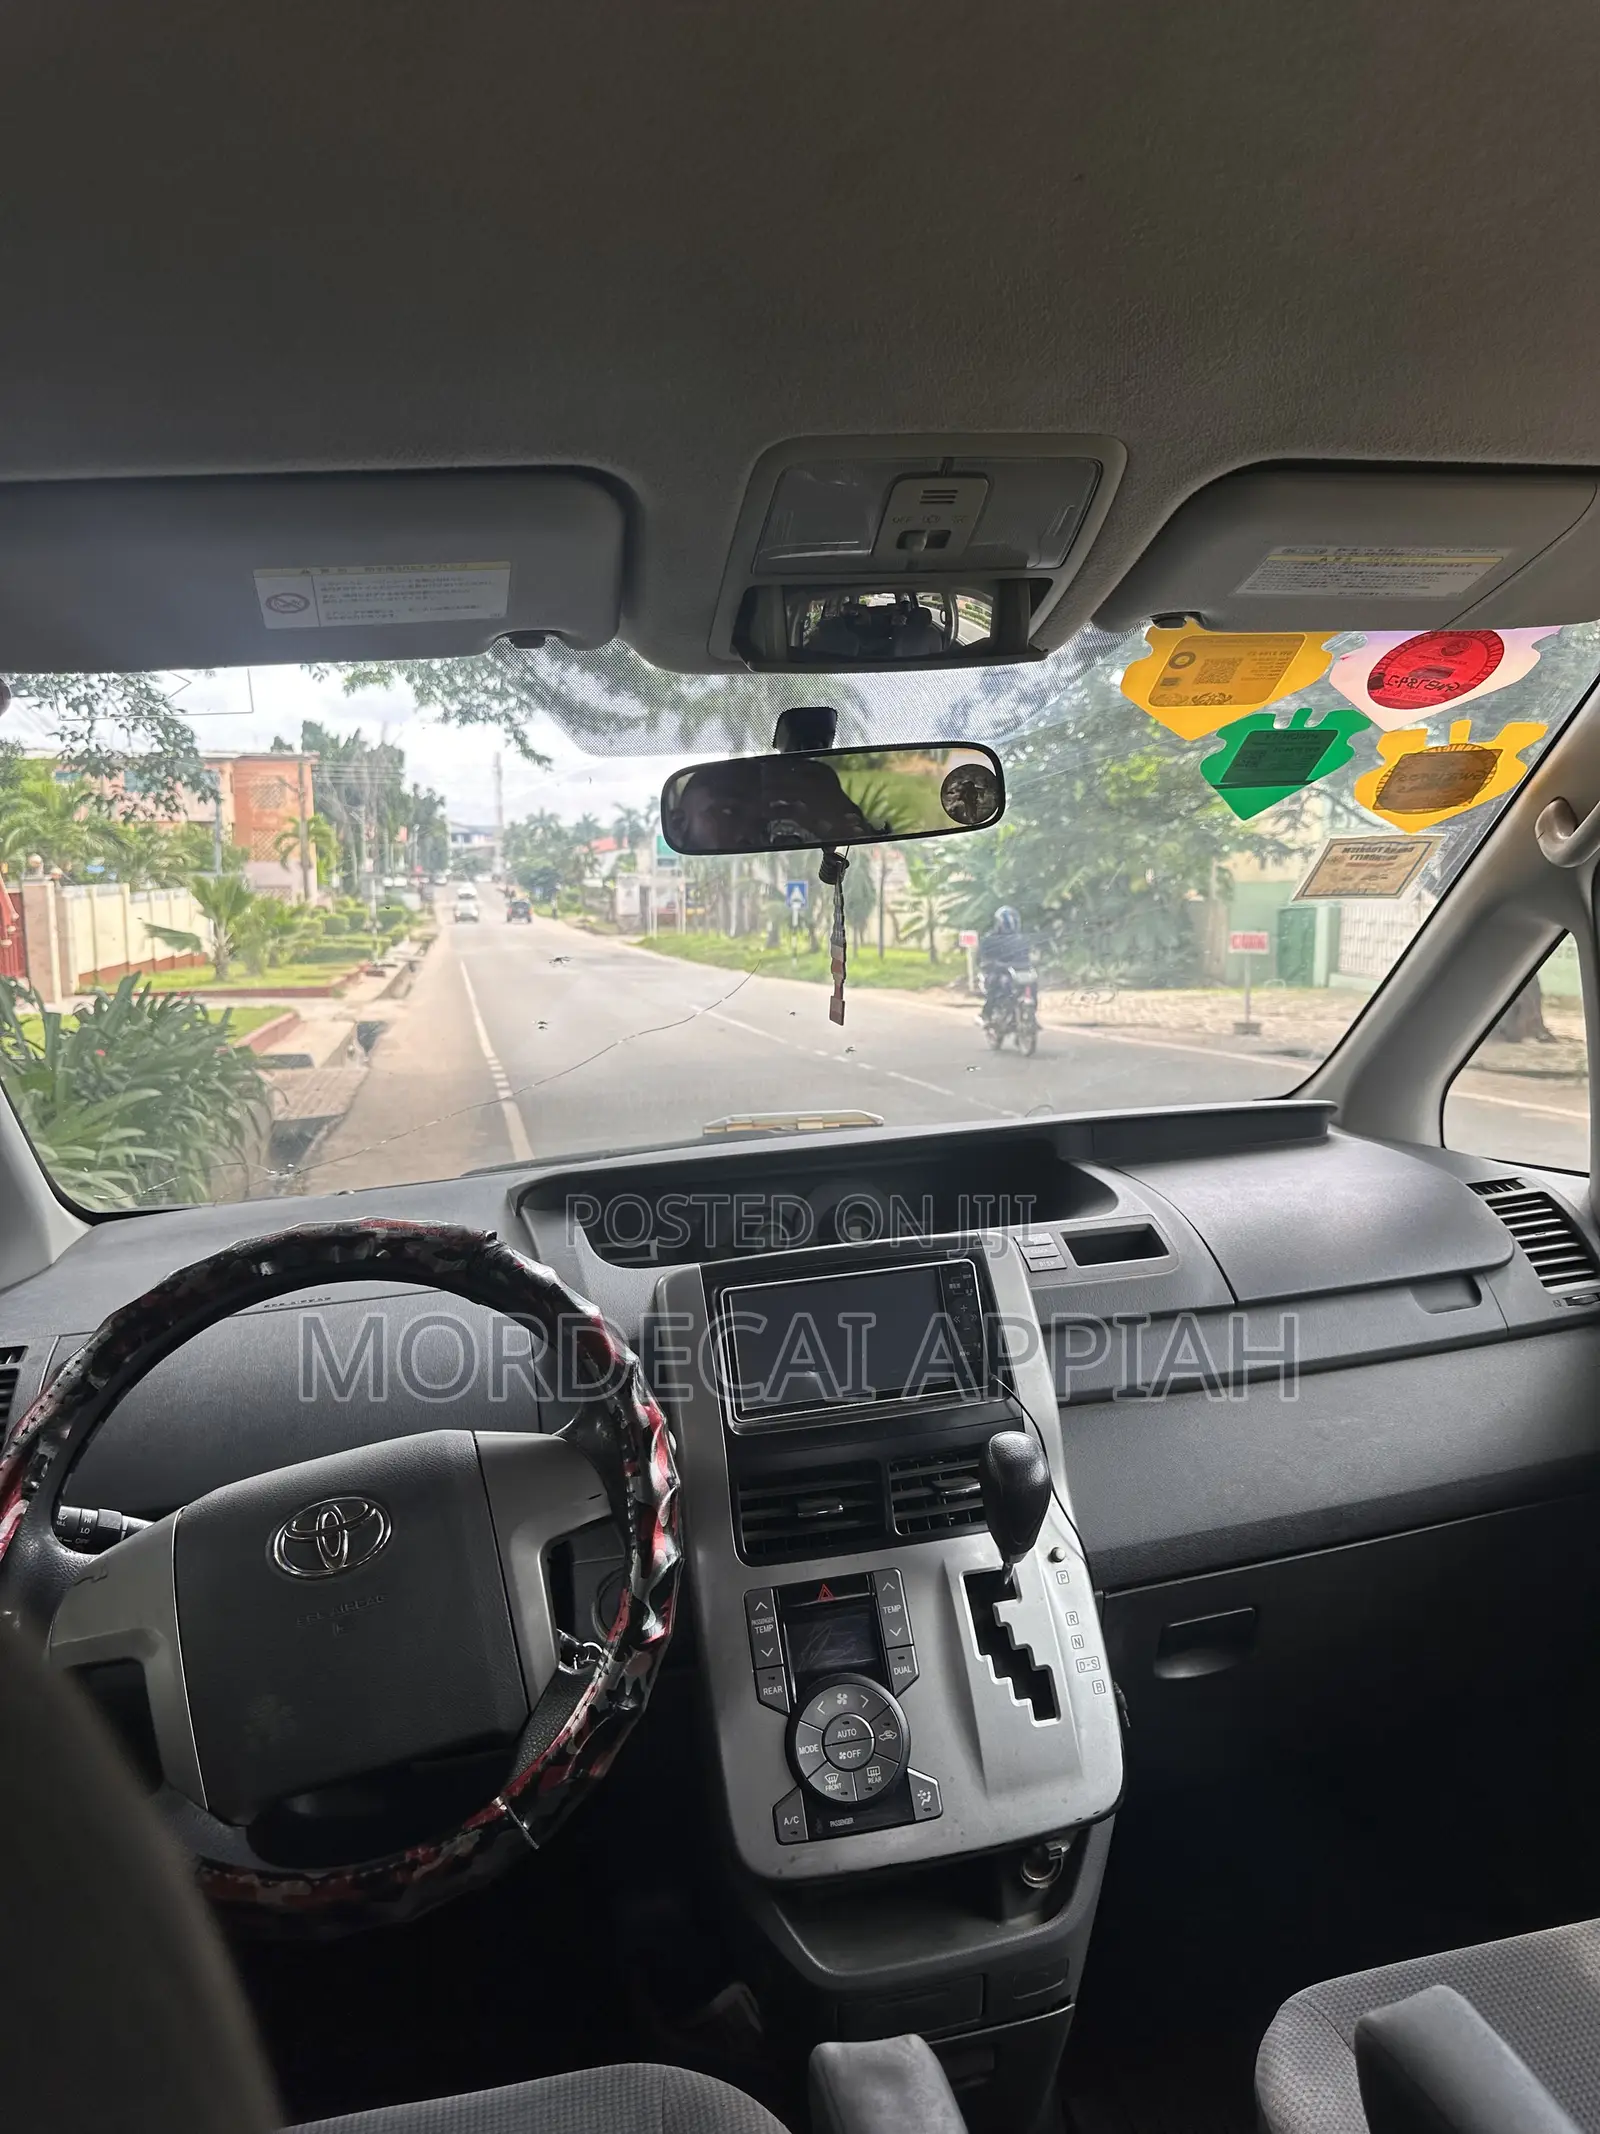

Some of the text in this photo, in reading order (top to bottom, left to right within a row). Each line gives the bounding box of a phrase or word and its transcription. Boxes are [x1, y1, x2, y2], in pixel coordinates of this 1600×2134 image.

[83, 1516, 92, 1525] HI
[80, 1527, 91, 1535] LO
[882, 1603, 902, 1615] TEMP
[754, 1624, 774, 1635] TEMP
[893, 1663, 913, 1676] DUAL
[1079, 1659, 1098, 1671] D-S
[763, 1685, 783, 1696] REAR
[837, 1728, 857, 1739] AUTO
[798, 1744, 819, 1755] MODE
[846, 1749, 862, 1759] OFF
[867, 1775, 882, 1785] REAR
[825, 1782, 842, 1792] FRONT
[783, 1816, 800, 1826] A/C
[829, 1817, 855, 1828] PASSENGER
